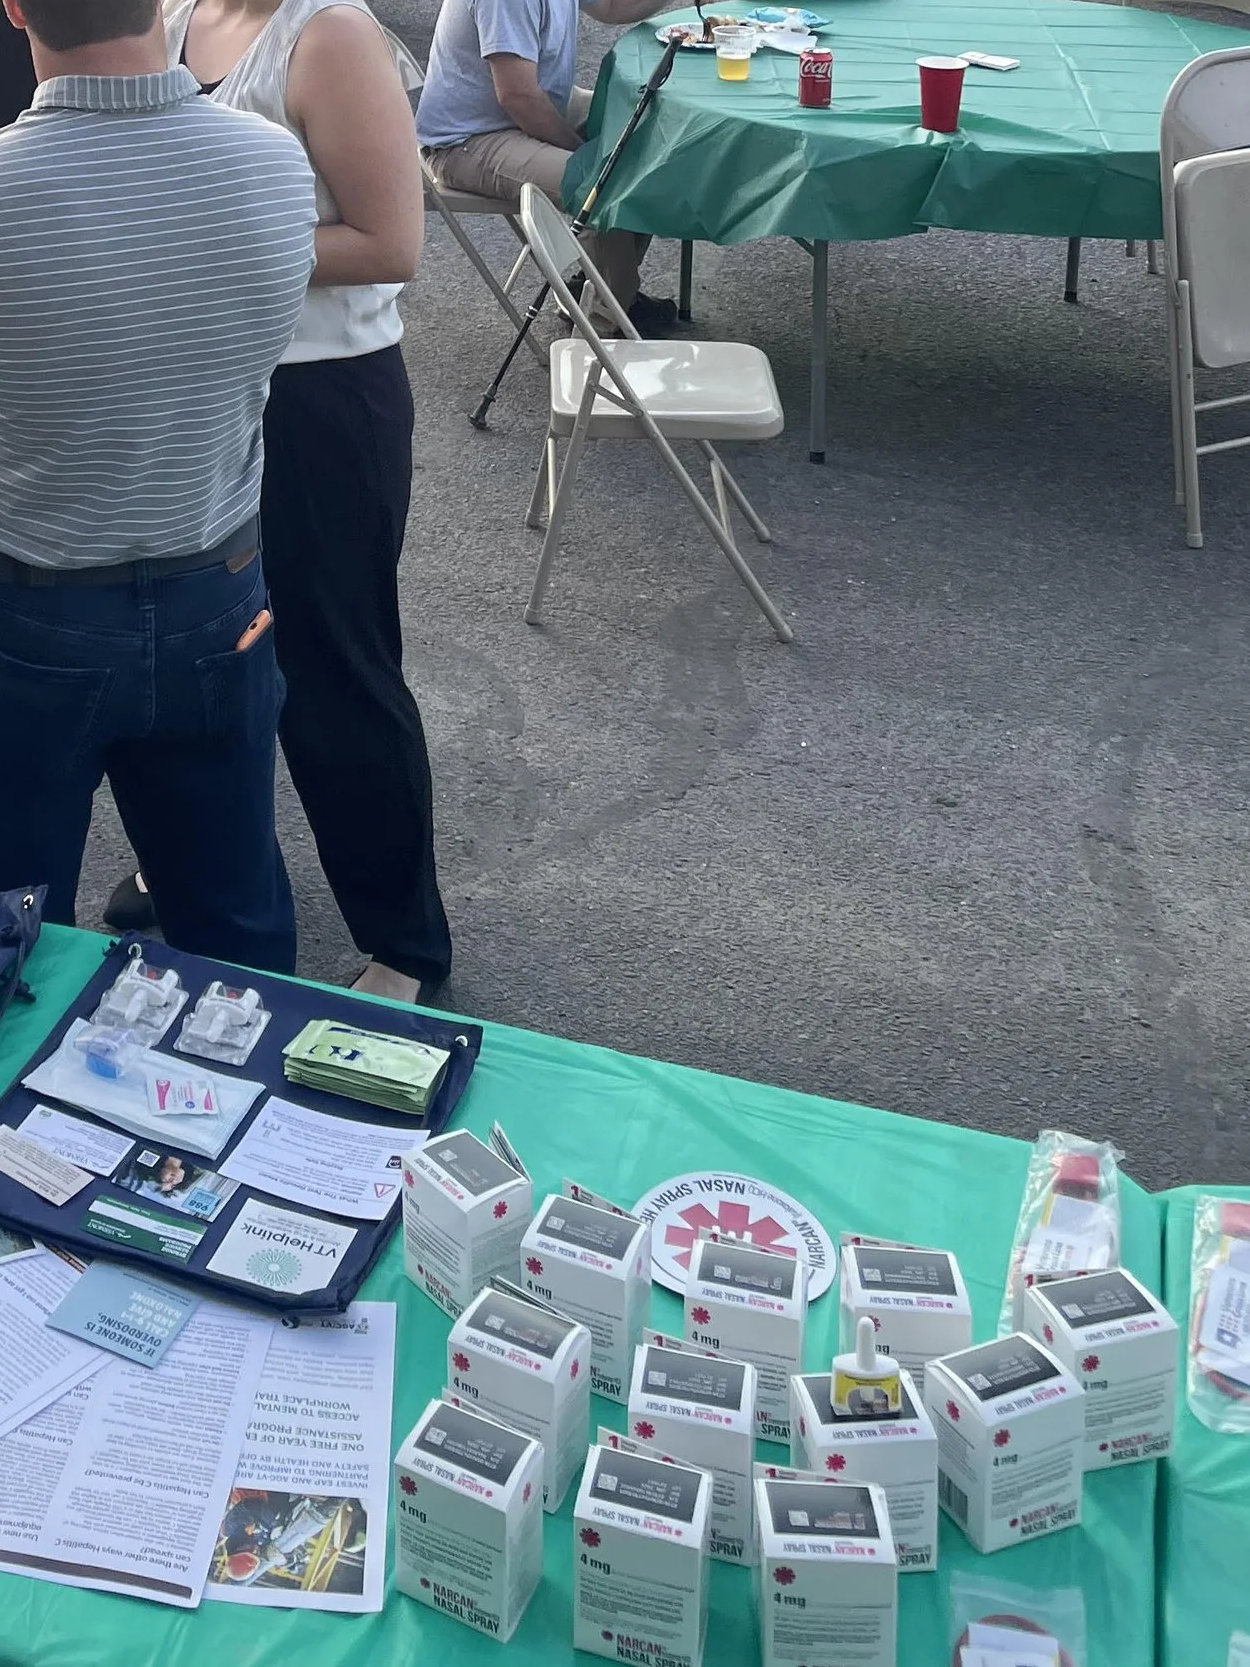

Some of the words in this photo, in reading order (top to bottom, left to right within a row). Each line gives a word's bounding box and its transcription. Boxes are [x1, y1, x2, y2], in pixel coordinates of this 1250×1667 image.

[693, 1178, 746, 1196] NASAL
[651, 1182, 693, 1211] SPRAY
[188, 1199, 208, 1211] 988
[526, 1279, 534, 1292] 4
[534, 1283, 553, 1301] mg
[84, 1321, 97, 1332] IS
[97, 1312, 163, 1348] OVERDOSING,
[95, 1324, 146, 1355] SOMEONE
[691, 1330, 699, 1342] 4
[700, 1335, 721, 1350] mg
[145, 1349, 156, 1358] IF
[453, 1376, 461, 1389] 4
[460, 1380, 480, 1400] mg
[590, 1377, 622, 1397] SPRAY
[254, 1402, 298, 1415] MENTAL
[282, 1394, 351, 1411] WORKPLACE
[300, 1407, 315, 1417] TO
[317, 1410, 360, 1422] ACCESS
[260, 1434, 275, 1444] OF
[295, 1427, 363, 1441] ASSISTANCE
[277, 1436, 307, 1448] YEAR
[309, 1440, 338, 1450] FREE
[341, 1443, 365, 1452] ONE
[311, 1460, 332, 1469] AND
[84, 1469, 134, 1485] prevented?
[291, 1476, 312, 1485] AND
[309, 1468, 369, 1481] PARTNERING
[152, 1479, 191, 1498] Hepatitis
[335, 1480, 368, 1489] INVEST
[399, 1498, 409, 1514] 4
[407, 1503, 428, 1525] mg
[709, 1540, 745, 1559] SPRAY
[149, 1555, 173, 1570] there
[173, 1562, 189, 1574] Are
[580, 1552, 588, 1566] 4
[589, 1559, 612, 1576] mg
[774, 1592, 782, 1604] 4
[783, 1594, 807, 1610] mg
[433, 1593, 466, 1621] NASAL
[466, 1609, 500, 1635] SPRAY
[616, 1645, 652, 1667] NASAL
